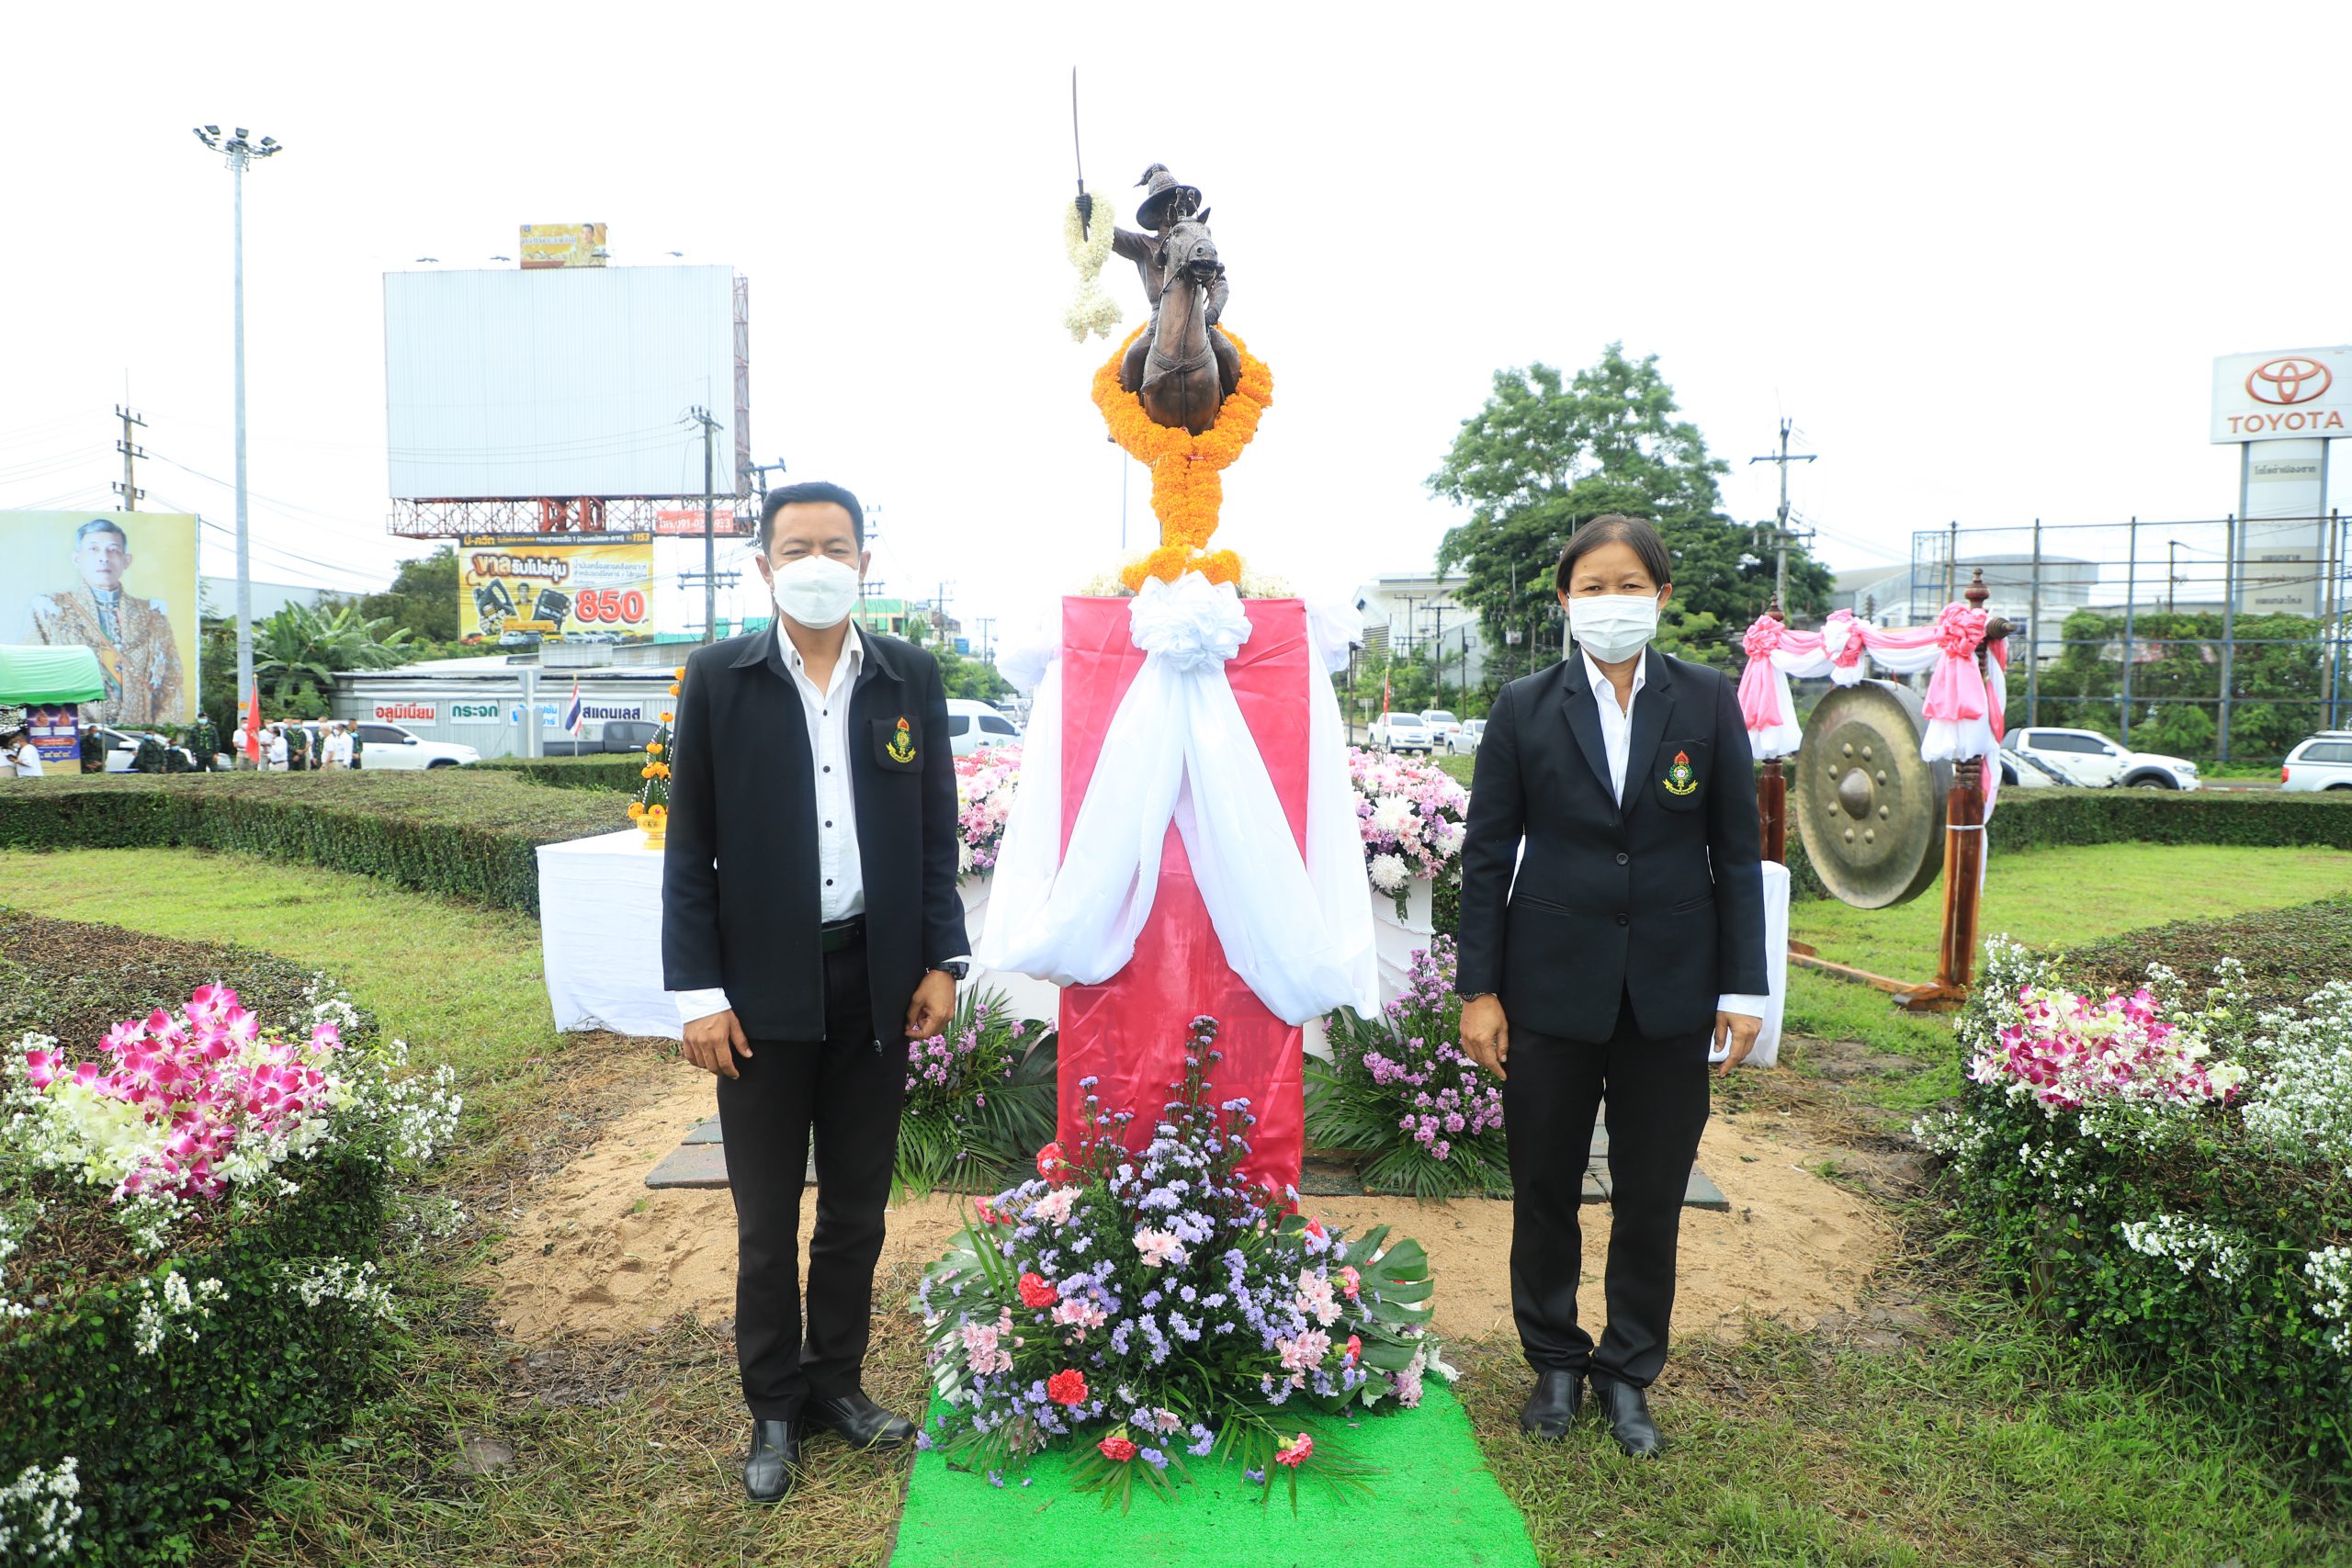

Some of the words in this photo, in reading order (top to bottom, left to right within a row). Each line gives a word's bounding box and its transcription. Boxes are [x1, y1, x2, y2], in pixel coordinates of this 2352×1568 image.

[2227, 411, 2345, 434] TOYOTA
[633, 532, 652, 542] 1153
[375, 702, 435, 723] อลูมิเนียม
[452, 705, 498, 717] กระจก
[582, 705, 641, 720] สแดนเลส
